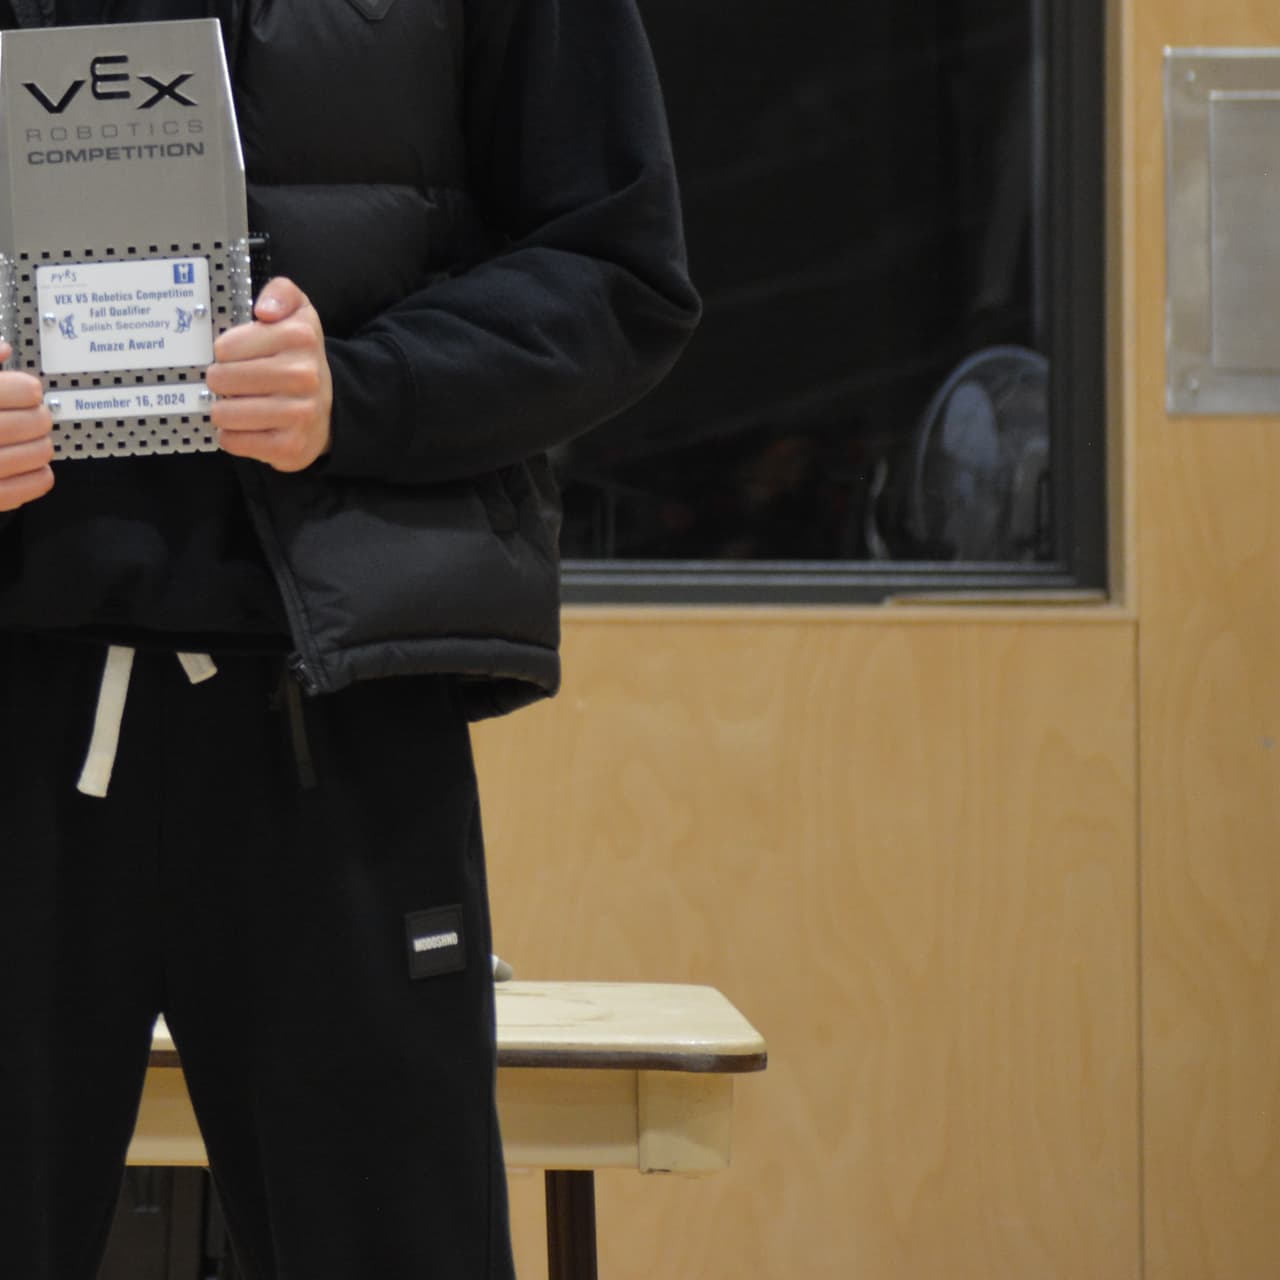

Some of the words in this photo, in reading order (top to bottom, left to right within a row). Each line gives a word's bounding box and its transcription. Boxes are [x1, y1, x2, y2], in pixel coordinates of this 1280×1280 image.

[21, 55, 198, 114] VEX
[26, 119, 204, 143] ROBOTICS
[27, 141, 205, 166] COMPETITION
[54, 294, 73, 305] VEX
[75, 293, 88, 304] V5
[91, 291, 133, 303] Robotics
[136, 288, 194, 302] Competition
[90, 307, 107, 318] Fall
[110, 305, 151, 317] Qualifier
[81, 321, 113, 333] Salish
[115, 318, 171, 330] Secondary
[89, 340, 125, 353] Amaze
[129, 337, 165, 351] Award
[75, 397, 132, 411] November
[136, 395, 153, 408] 16,
[157, 393, 185, 405] 2024
